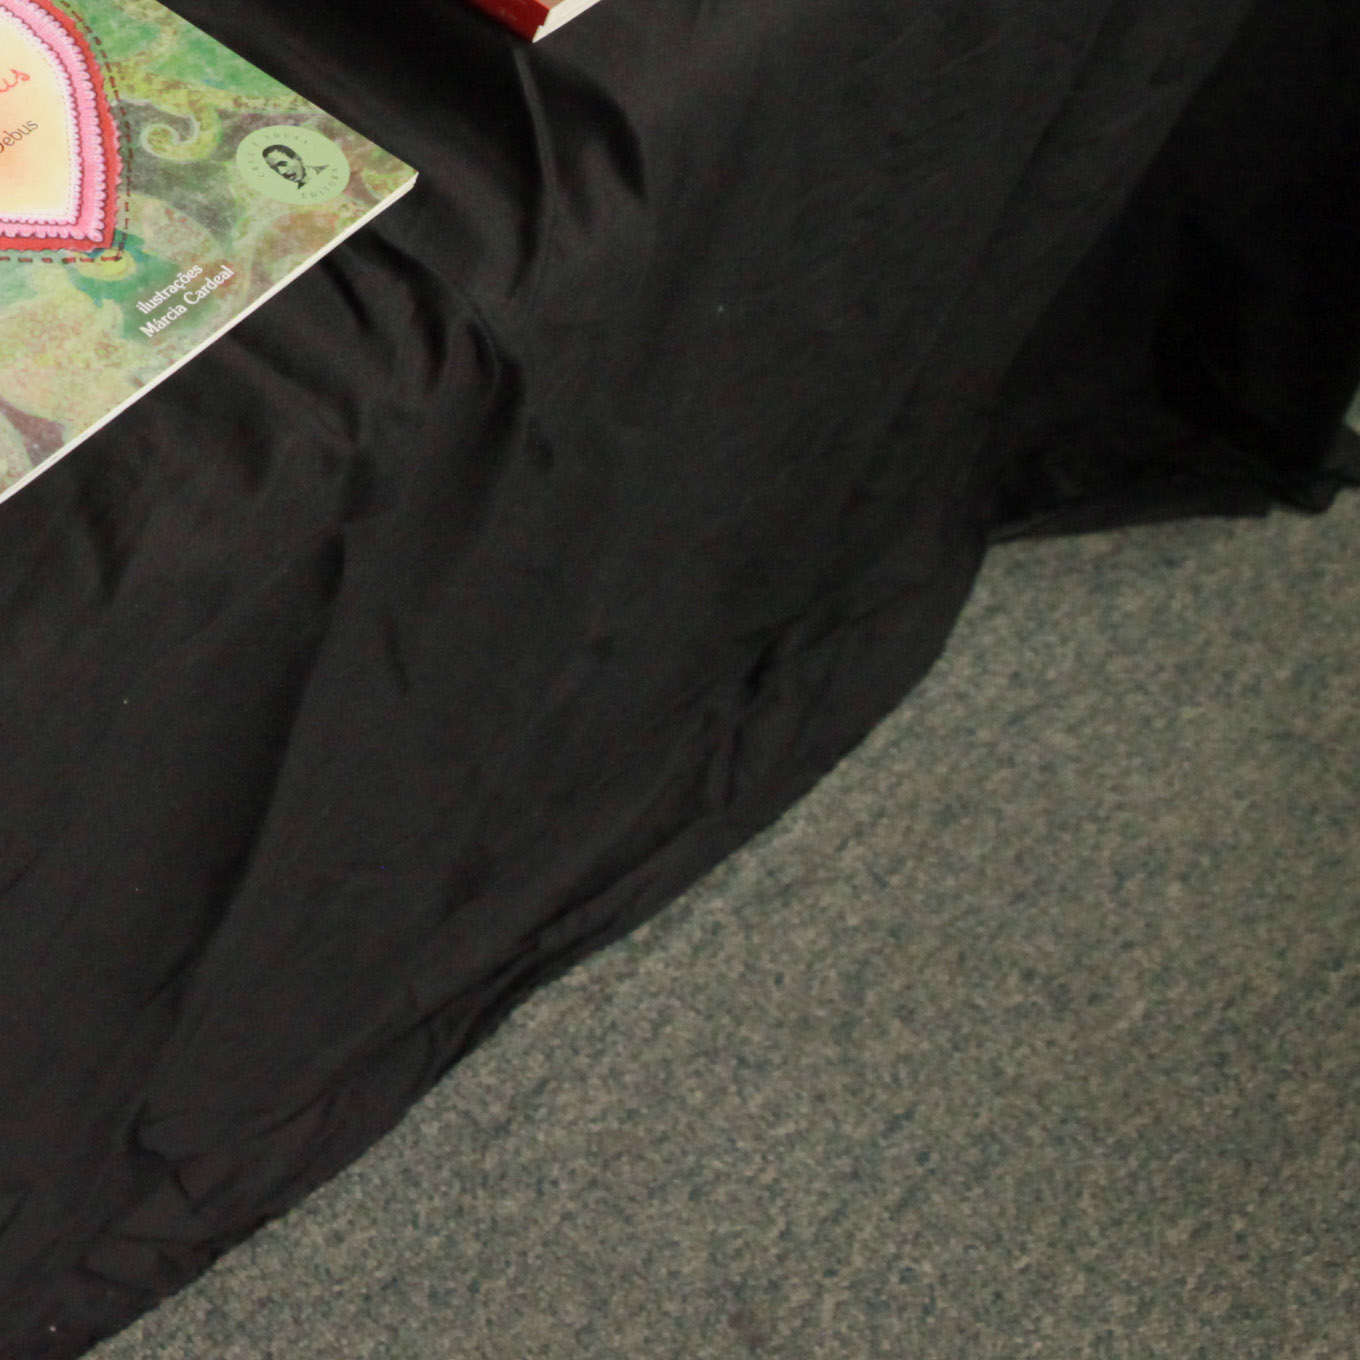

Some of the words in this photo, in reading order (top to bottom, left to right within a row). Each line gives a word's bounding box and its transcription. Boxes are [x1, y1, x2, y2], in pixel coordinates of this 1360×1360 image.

[135, 263, 204, 316] ilustrações
[138, 303, 188, 339] Márcia
[183, 263, 235, 306] Cardeal
